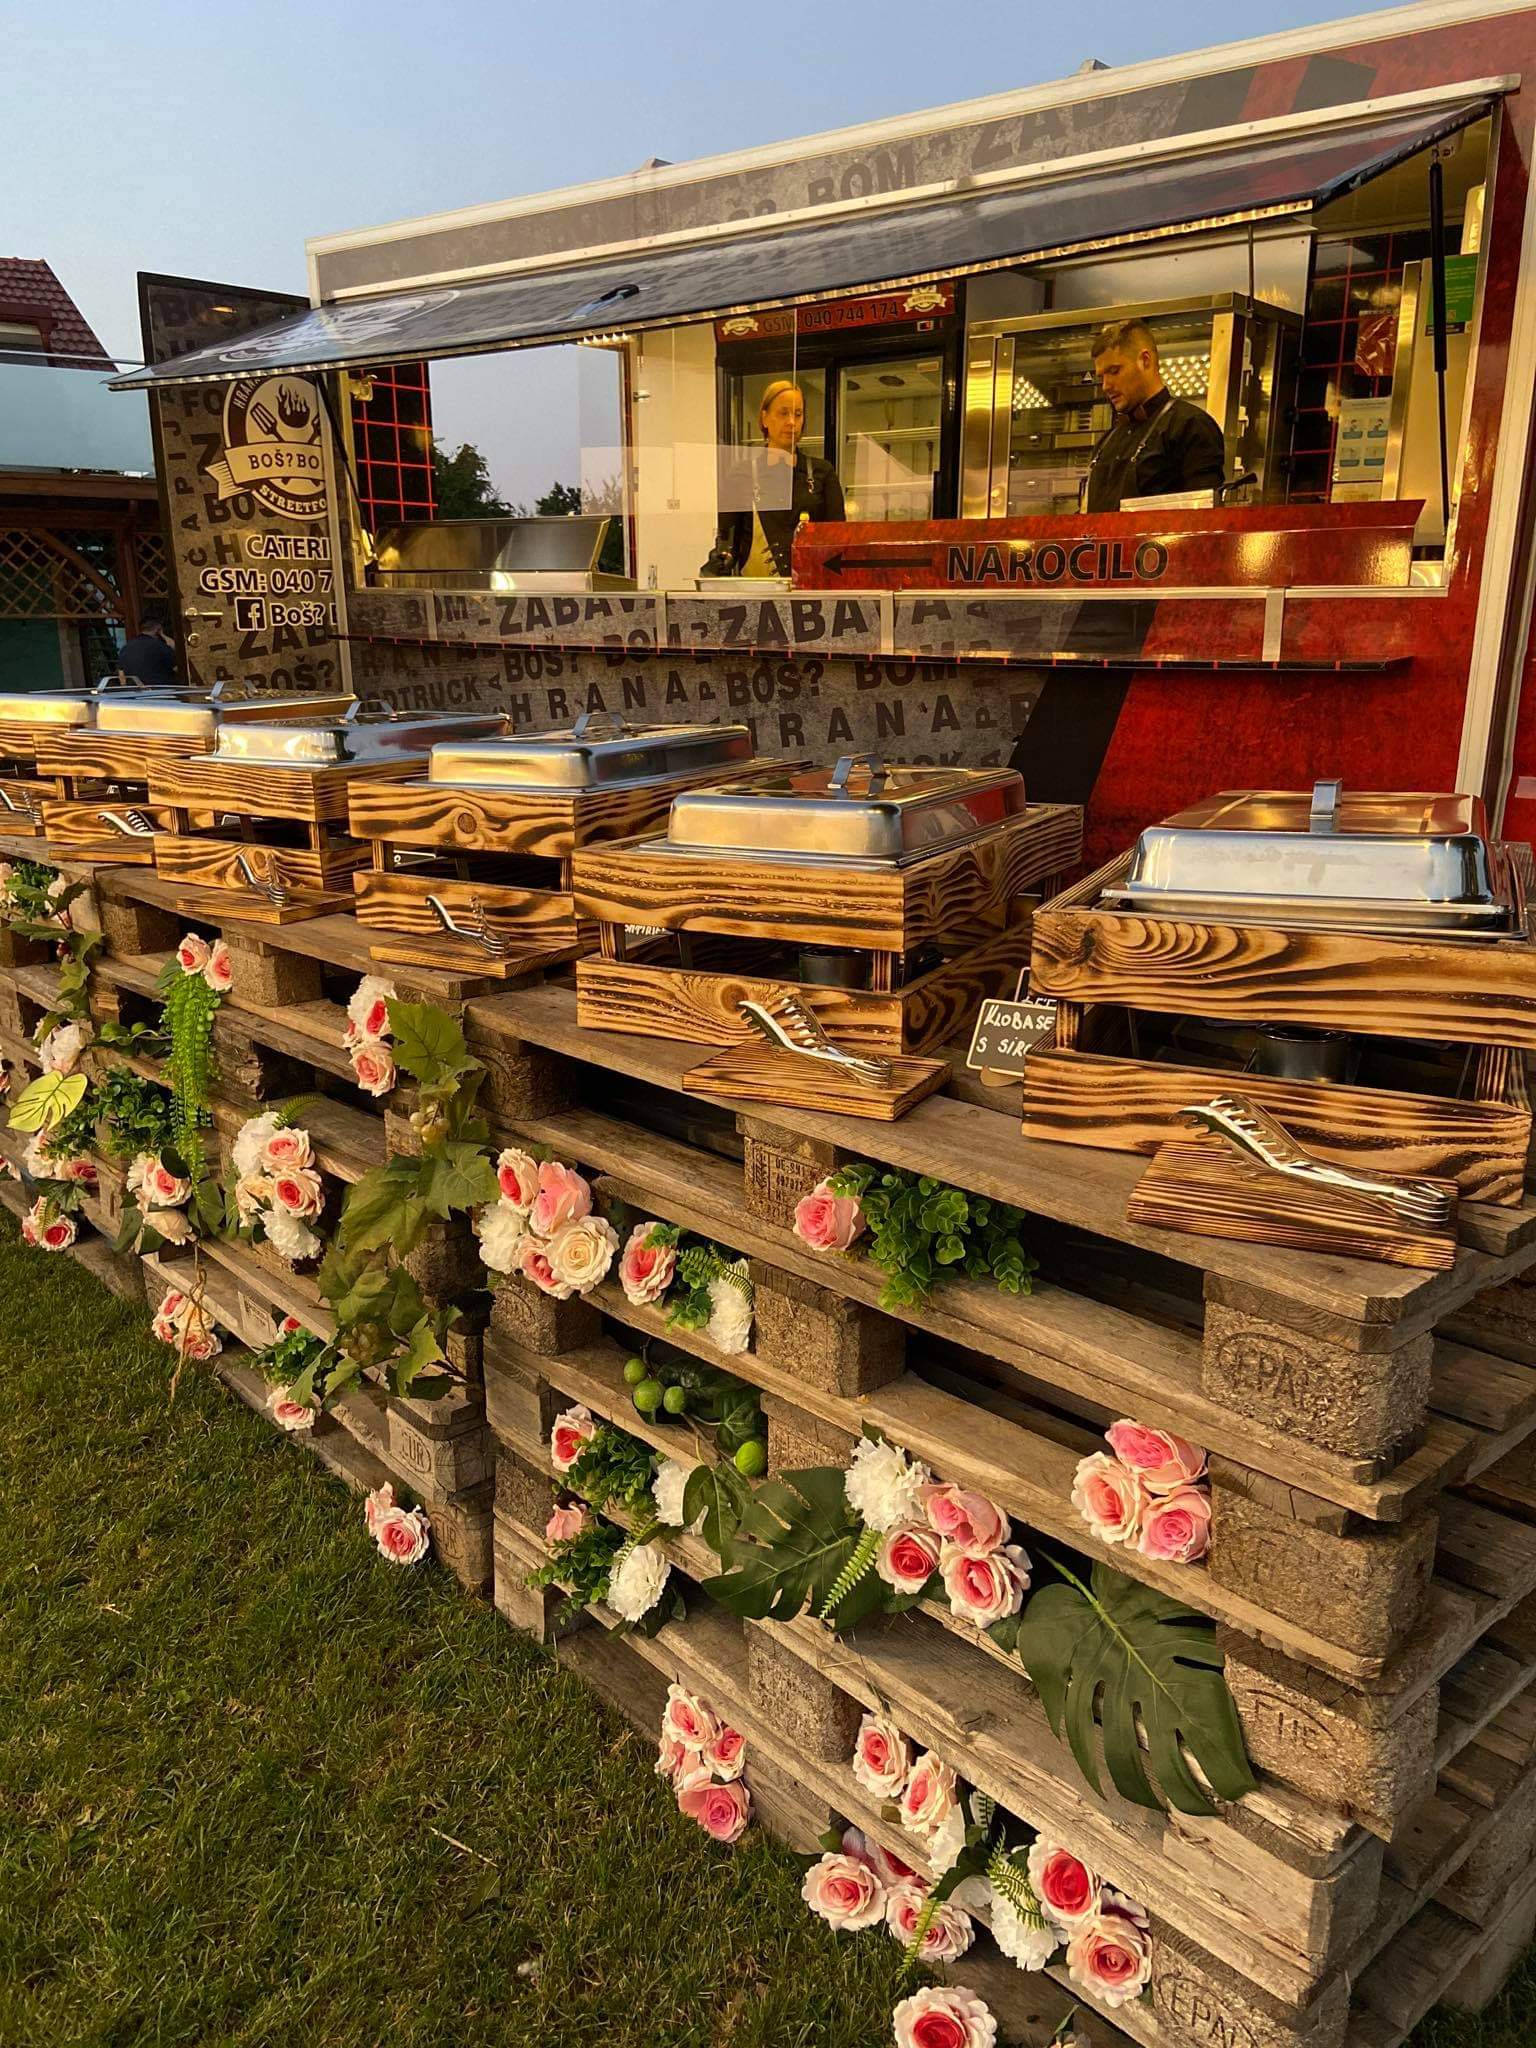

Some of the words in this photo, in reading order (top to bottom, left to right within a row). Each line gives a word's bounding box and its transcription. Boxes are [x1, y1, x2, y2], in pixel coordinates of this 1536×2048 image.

[804, 310, 833, 329] 040
[837, 305, 865, 324] 744
[870, 301, 899, 319] 174
[946, 535, 1169, 583] NAROČILO
[199, 567, 267, 593] GSM:
[271, 568, 316, 593] 040
[270, 602, 326, 627] Boš?
[983, 1003, 1056, 1031] KLOBASE
